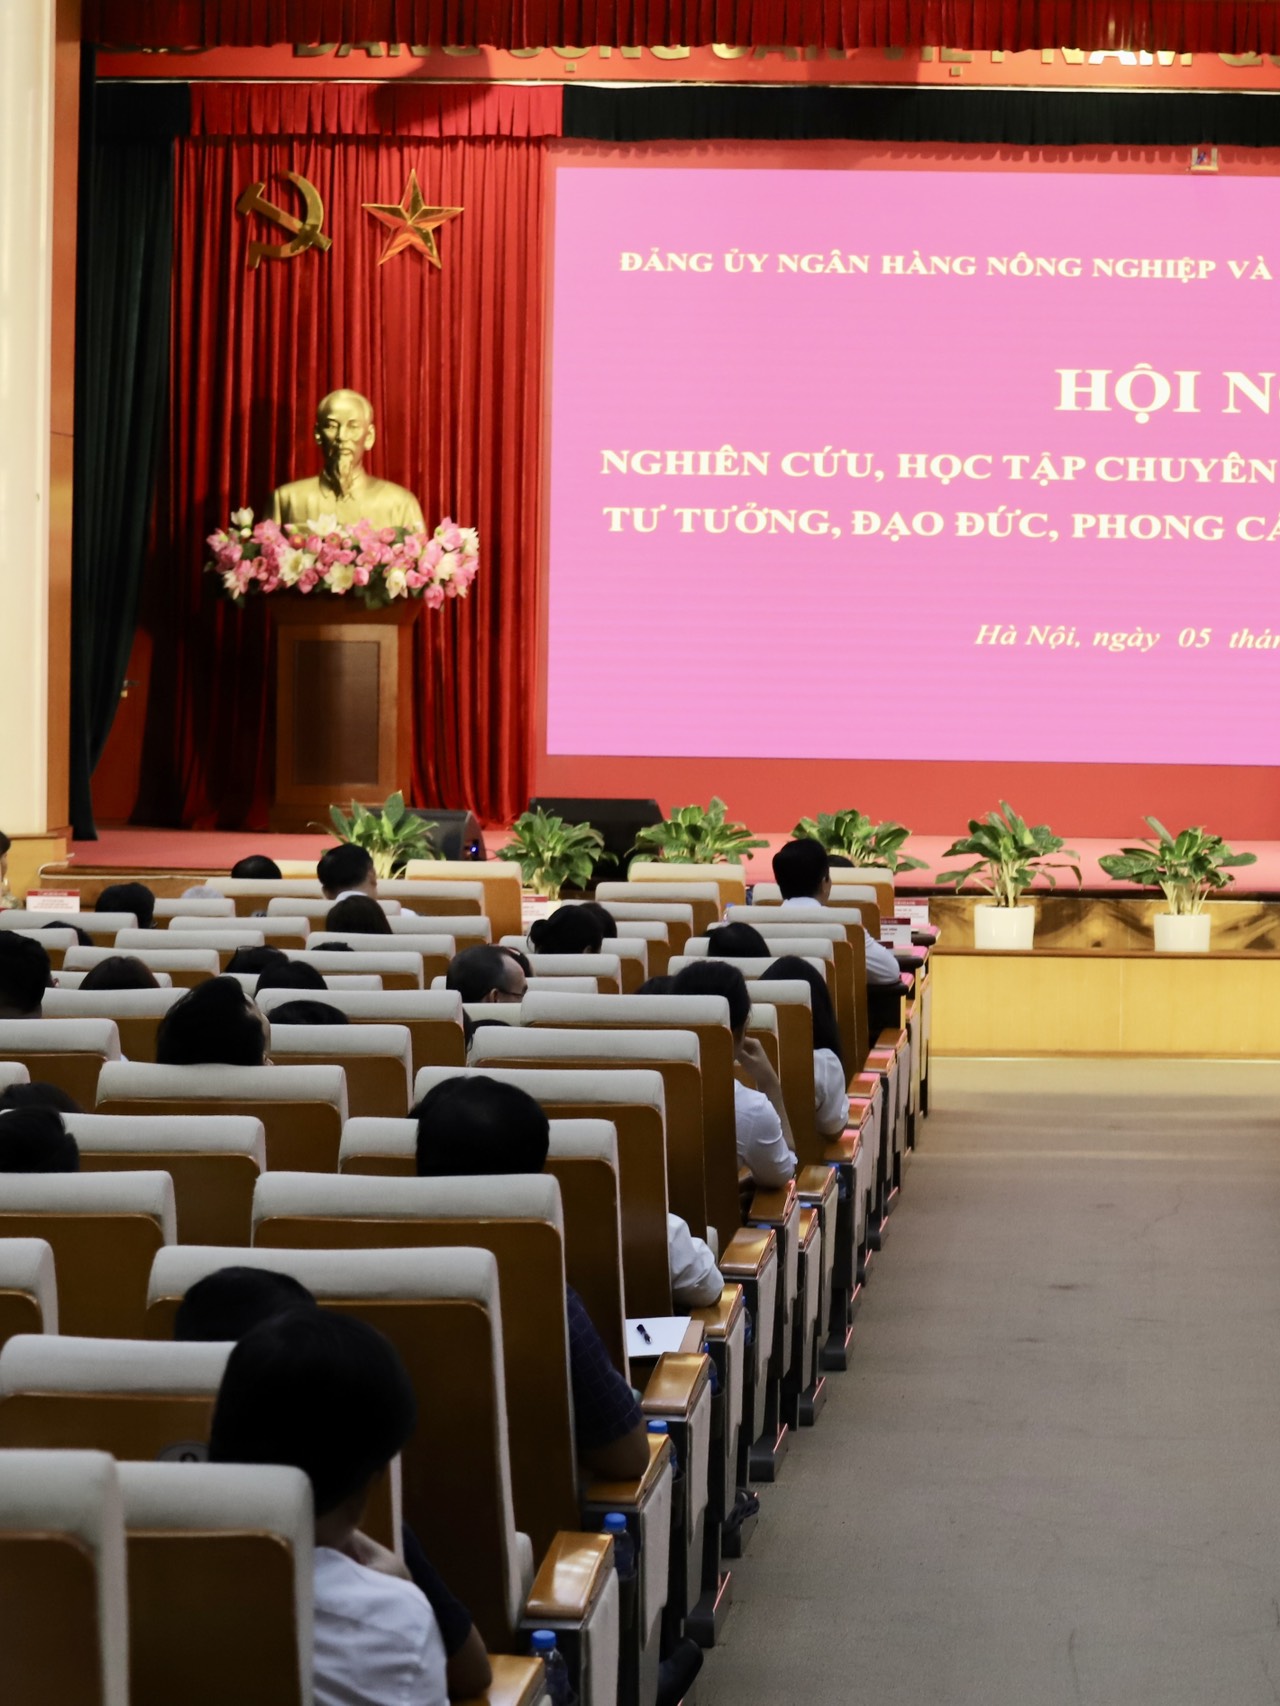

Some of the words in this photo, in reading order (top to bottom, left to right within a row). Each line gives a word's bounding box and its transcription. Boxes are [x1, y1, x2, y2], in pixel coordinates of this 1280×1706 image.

[619, 246, 714, 273] ĐẢNG
[723, 247, 769, 273] ỦY
[777, 248, 870, 274] NGÂN
[880, 249, 977, 276] HÀNG
[986, 251, 1083, 278] NÔNG
[1091, 256, 1217, 284] NGHIỆP
[1226, 255, 1273, 281] VÀ
[1054, 362, 1202, 425] HỘI
[600, 443, 771, 477] NGHIÊN
[780, 444, 885, 483] CỨU,
[896, 453, 993, 486] HỌC
[1001, 451, 1087, 487] TẬP
[1094, 451, 1278, 484] CHUYÊN
[602, 503, 668, 533] TƯ
[672, 501, 842, 540] TƯỞNG,
[851, 509, 945, 543] ĐẠO
[954, 504, 1059, 543] ĐỨC,
[1071, 513, 1225, 541] PHONG
[974, 624, 1018, 646] Hà
[1024, 624, 1081, 650] Nội,
[1092, 626, 1161, 653] ngày
[1177, 627, 1213, 649] 05
